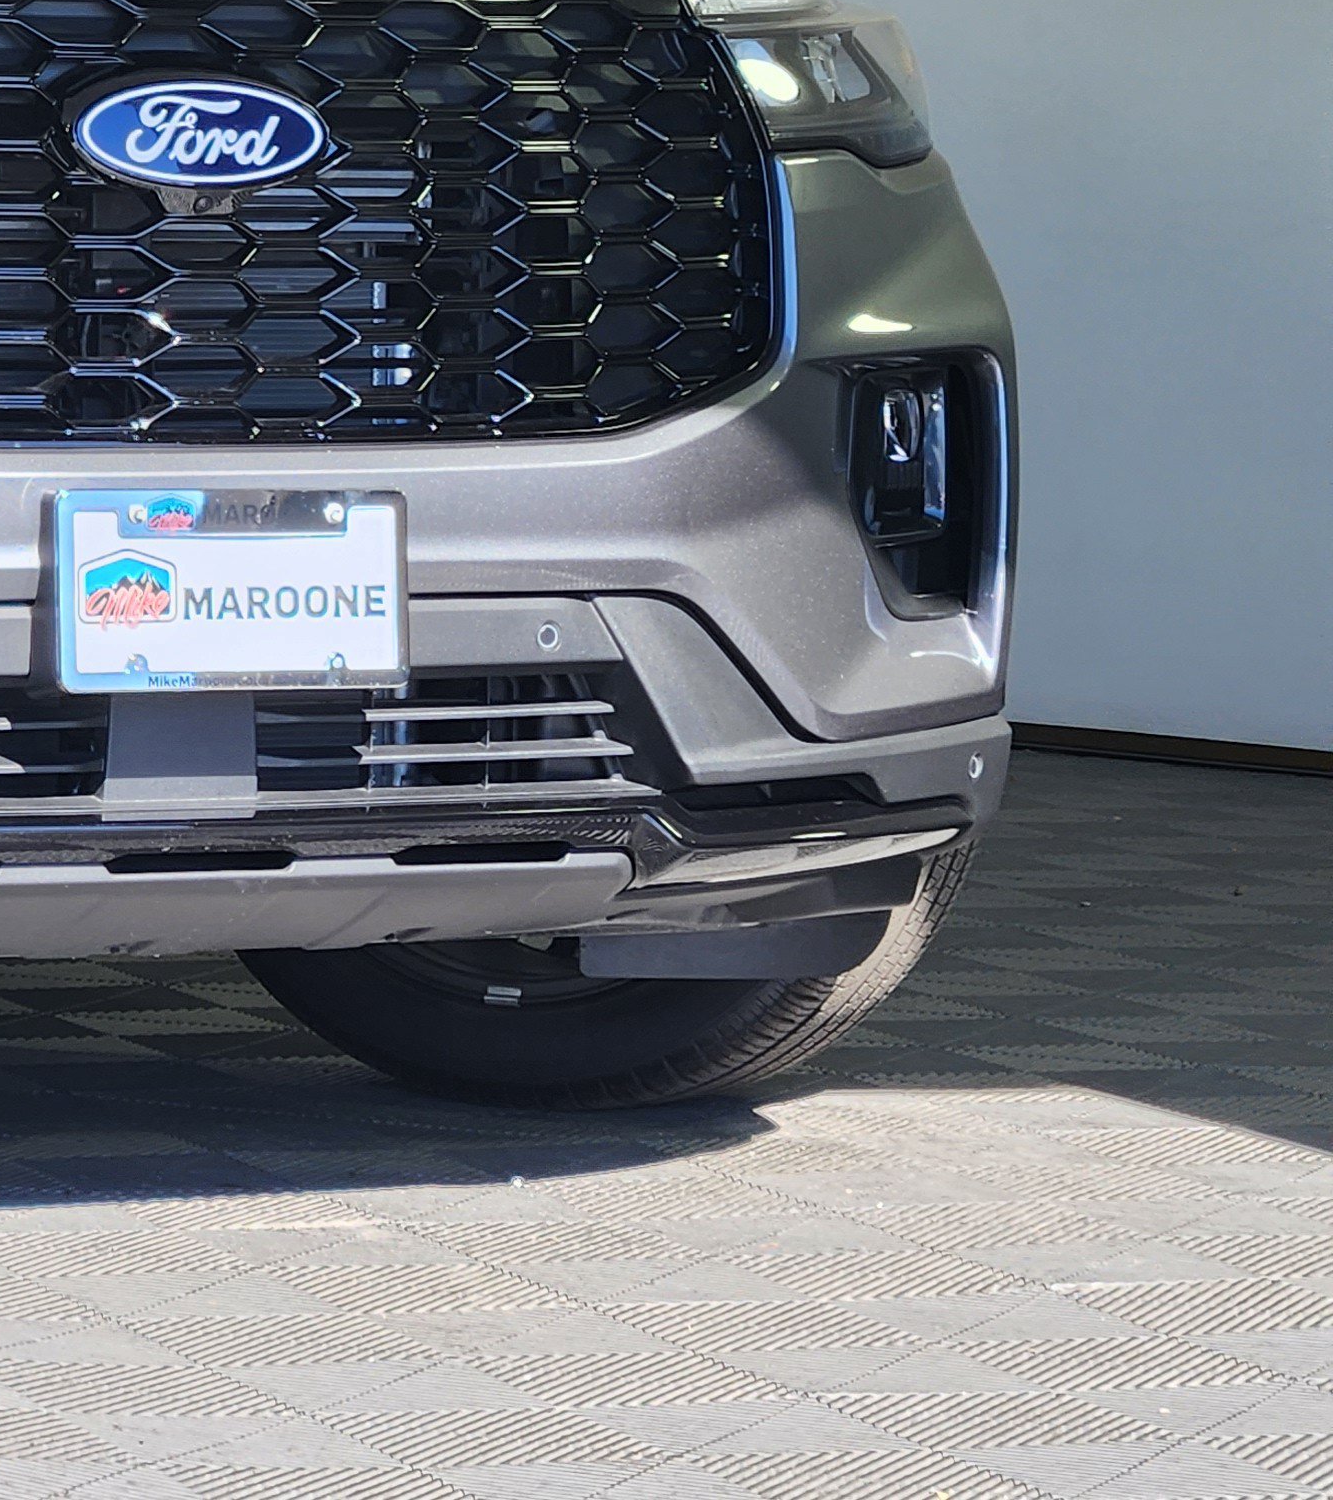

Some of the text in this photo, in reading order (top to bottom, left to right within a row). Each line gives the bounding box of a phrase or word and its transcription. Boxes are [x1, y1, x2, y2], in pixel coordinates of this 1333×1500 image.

[125, 94, 281, 167] Ford
[86, 582, 386, 632] Mike MAROONE
